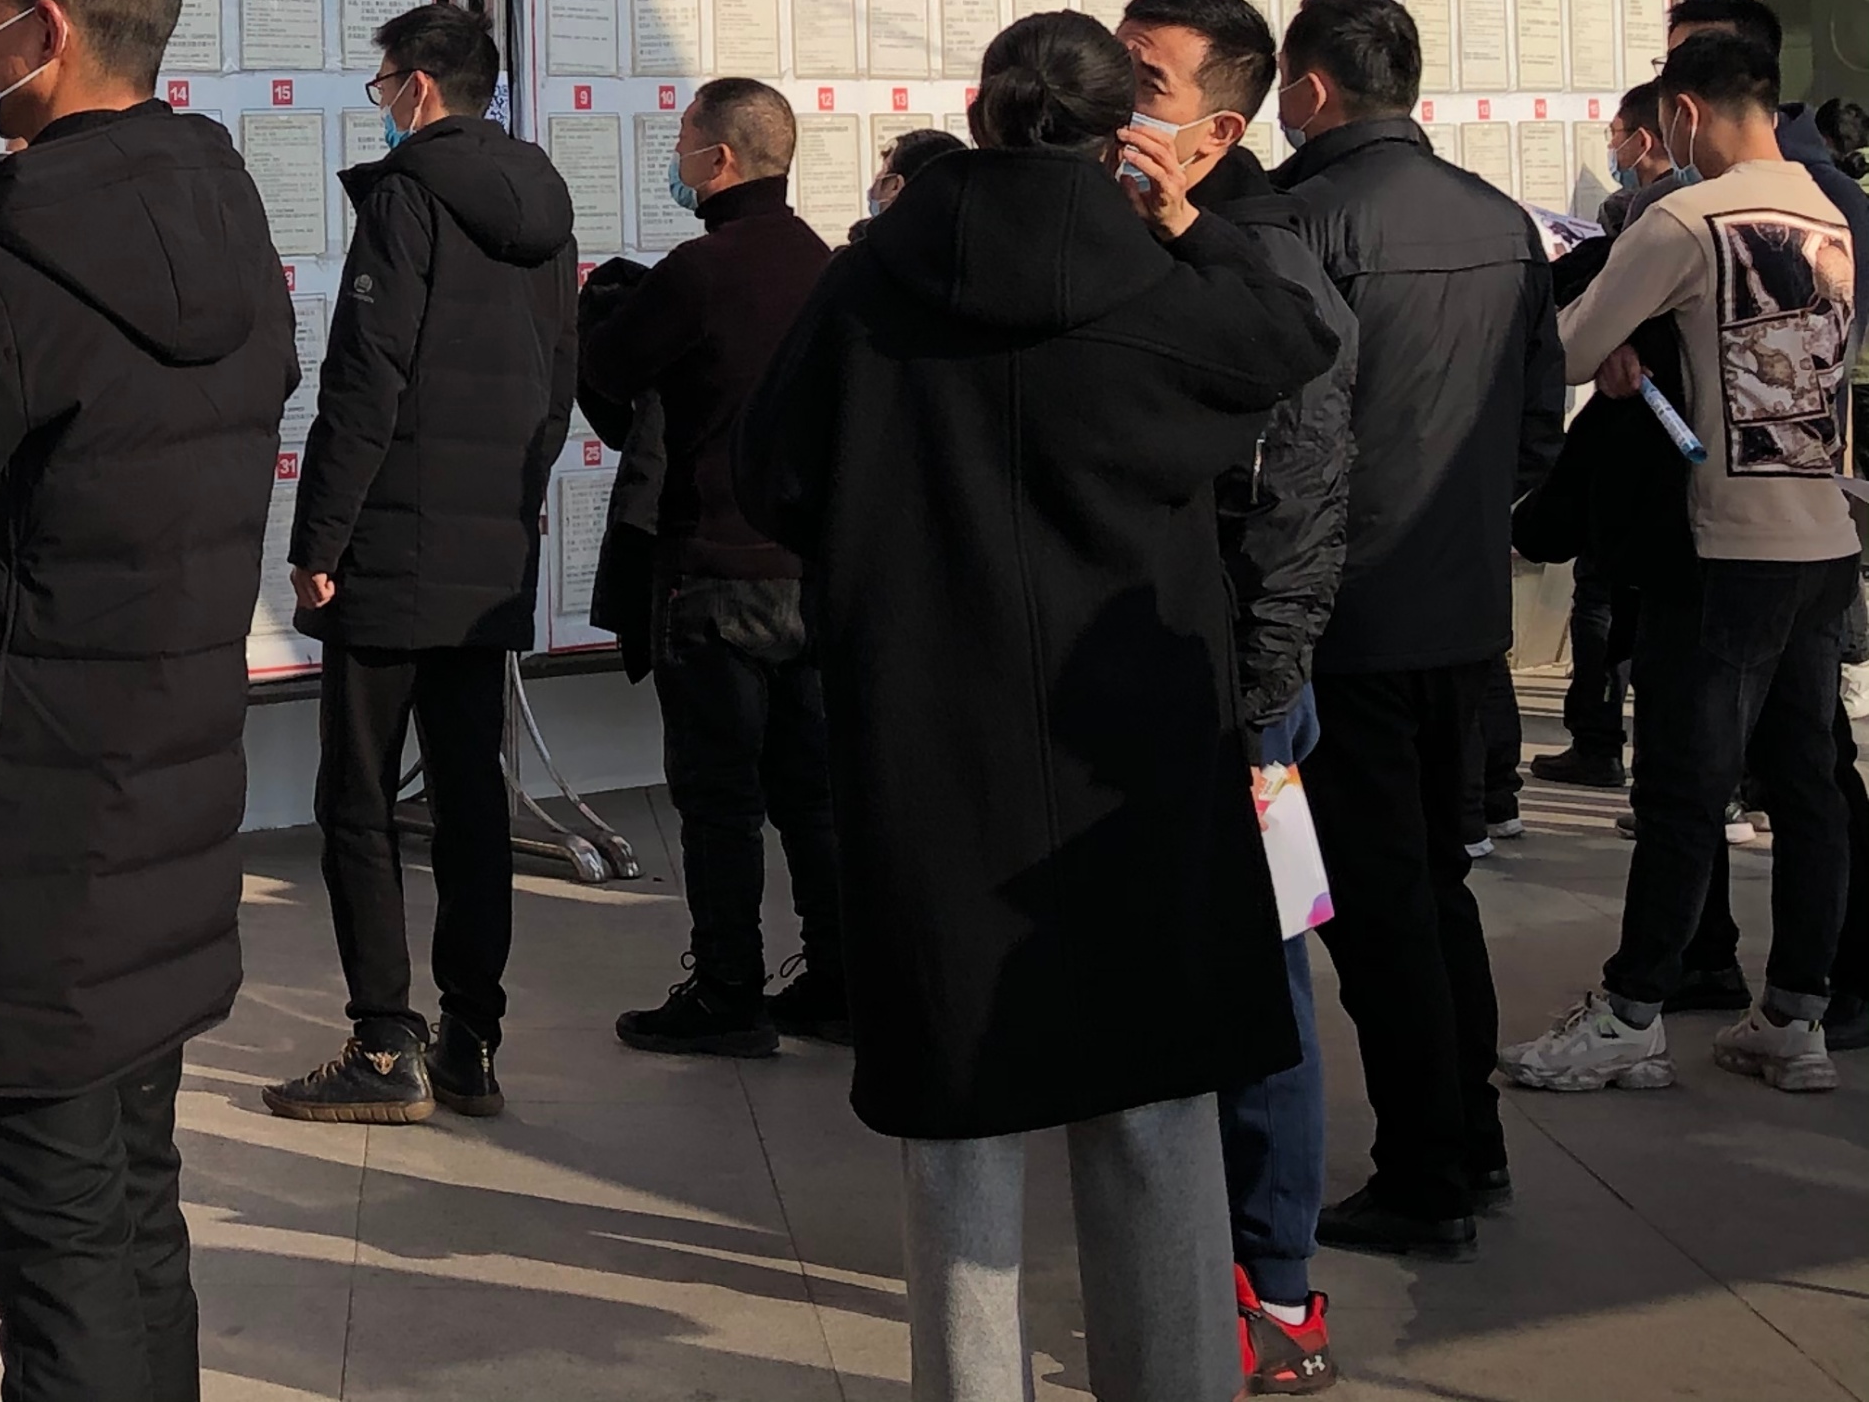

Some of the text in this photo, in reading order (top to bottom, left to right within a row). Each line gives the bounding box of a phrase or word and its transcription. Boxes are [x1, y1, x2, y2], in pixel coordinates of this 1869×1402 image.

[170, 86, 187, 101] 14
[274, 86, 291, 100] 15
[579, 91, 588, 105] 9
[661, 90, 674, 105] 10
[820, 93, 833, 106] 12
[894, 93, 907, 106] 13
[585, 445, 601, 461] 25
[279, 459, 296, 474] 31
